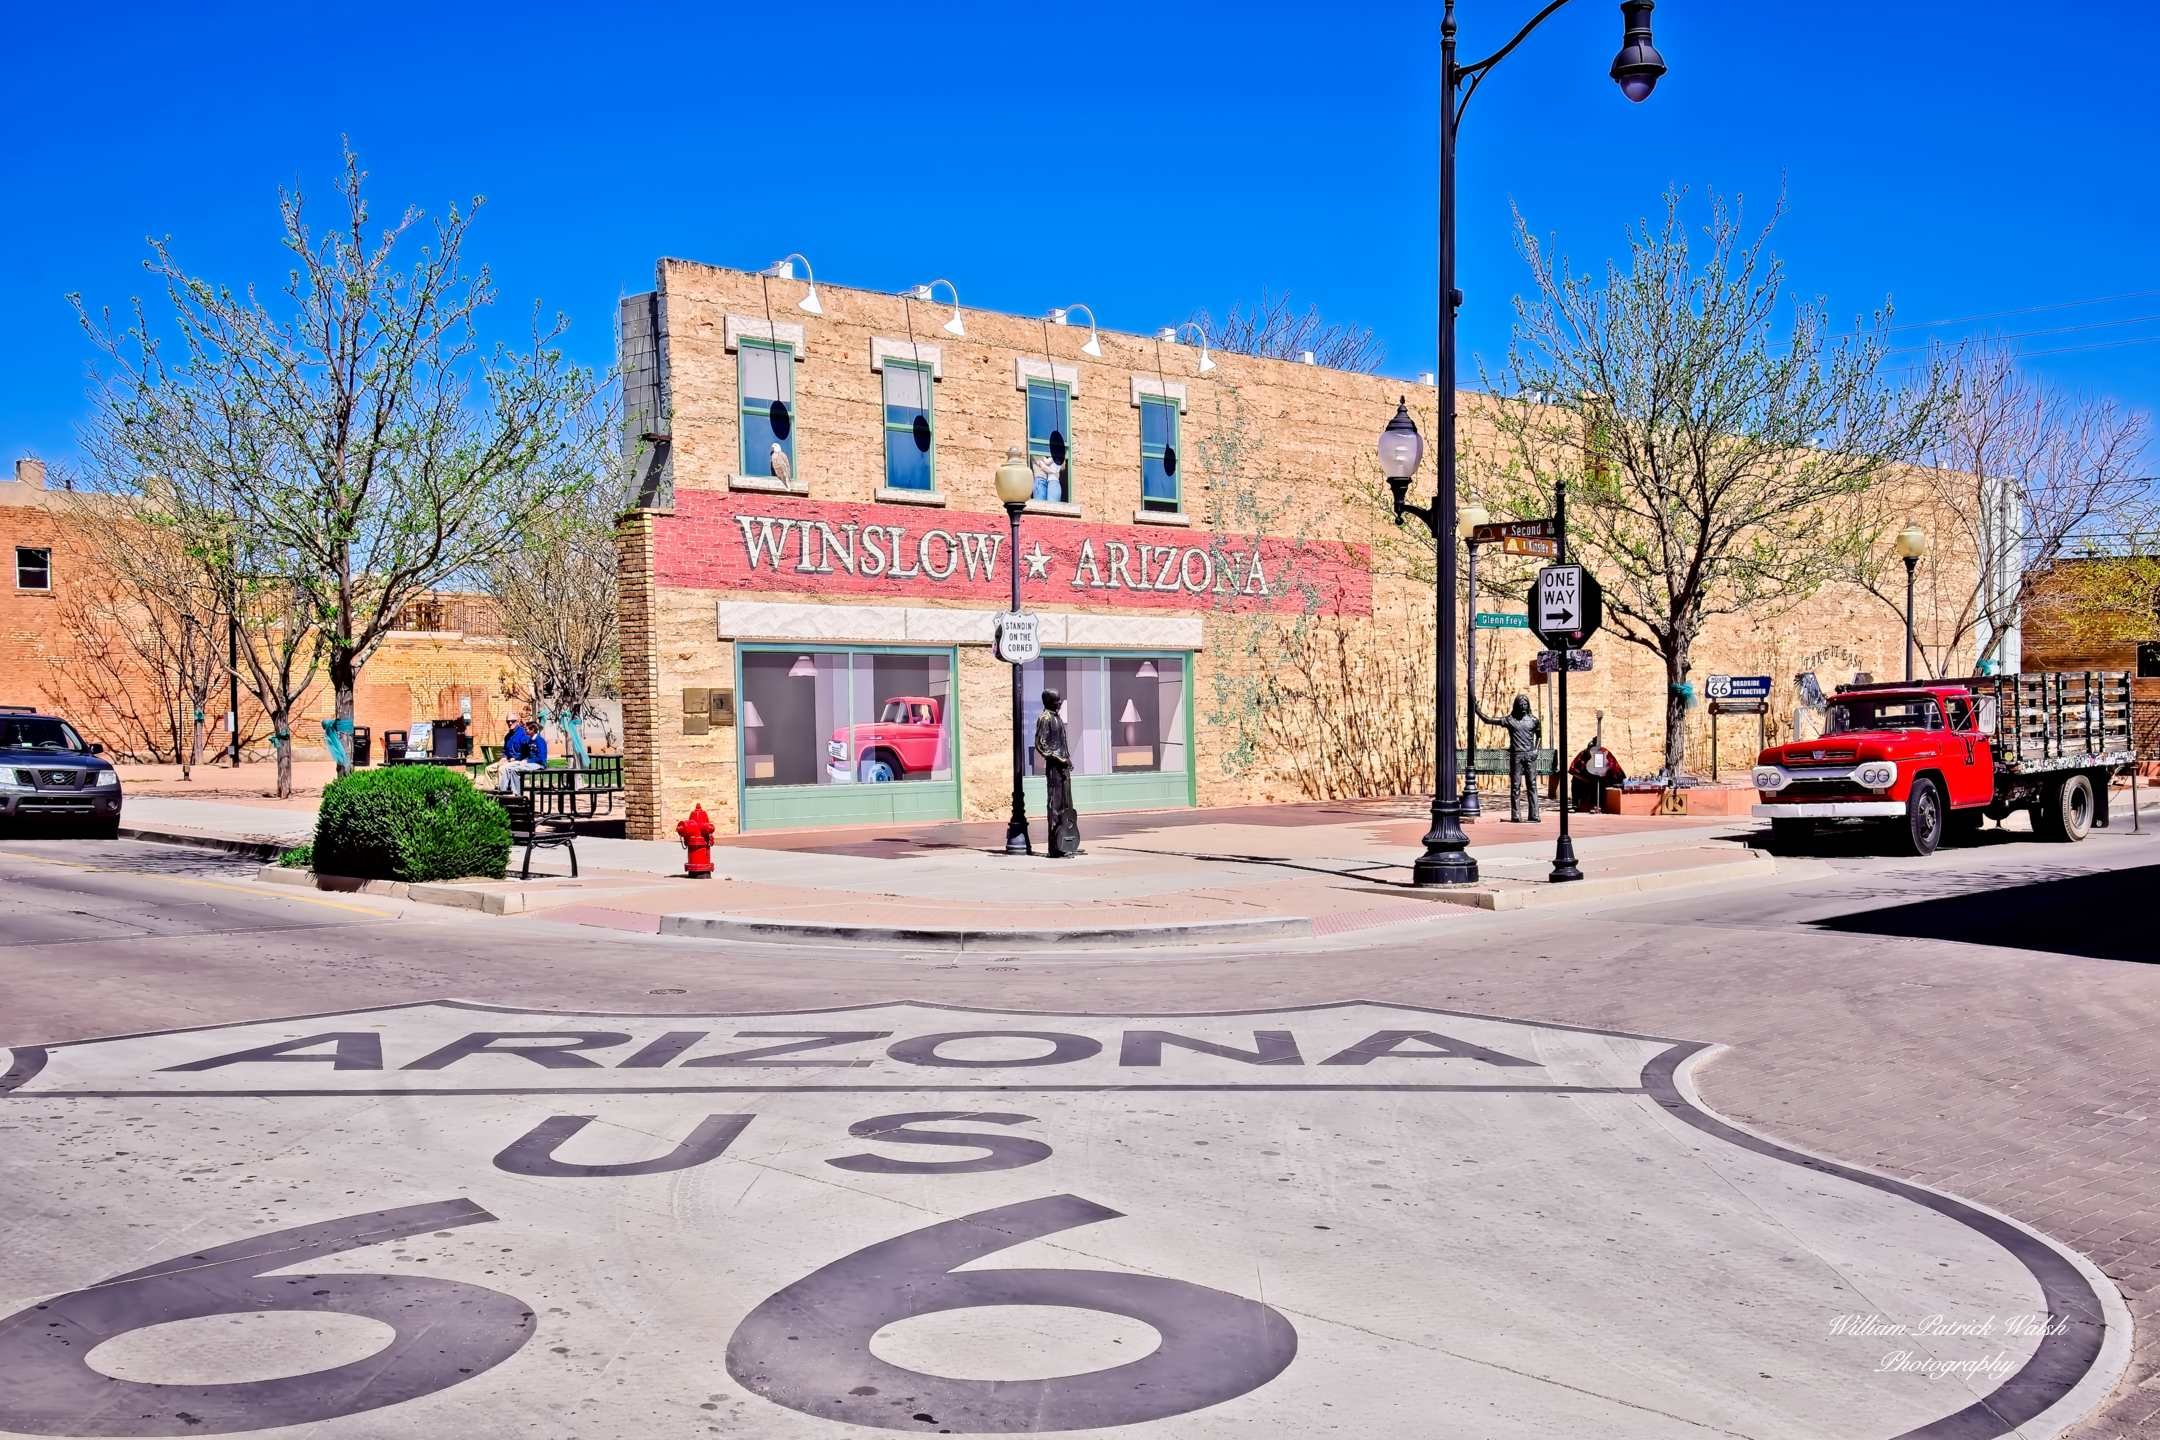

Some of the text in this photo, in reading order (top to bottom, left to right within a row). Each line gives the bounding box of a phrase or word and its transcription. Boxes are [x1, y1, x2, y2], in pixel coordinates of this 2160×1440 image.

[1511, 523, 1541, 536] Second
[735, 515, 1269, 596] WINSLOW ARIZONA
[1545, 572, 1575, 587] ONE
[1544, 590, 1575, 605] WAY
[1005, 622, 1034, 630] STANDIN'
[1482, 615, 1504, 625] Glenn
[1505, 616, 1523, 627] Frey
[1009, 632, 1031, 642] ON THE
[1007, 643, 1033, 652] CORNER
[1711, 683, 1728, 695] 66
[158, 1030, 1542, 1071] ARIZONA
